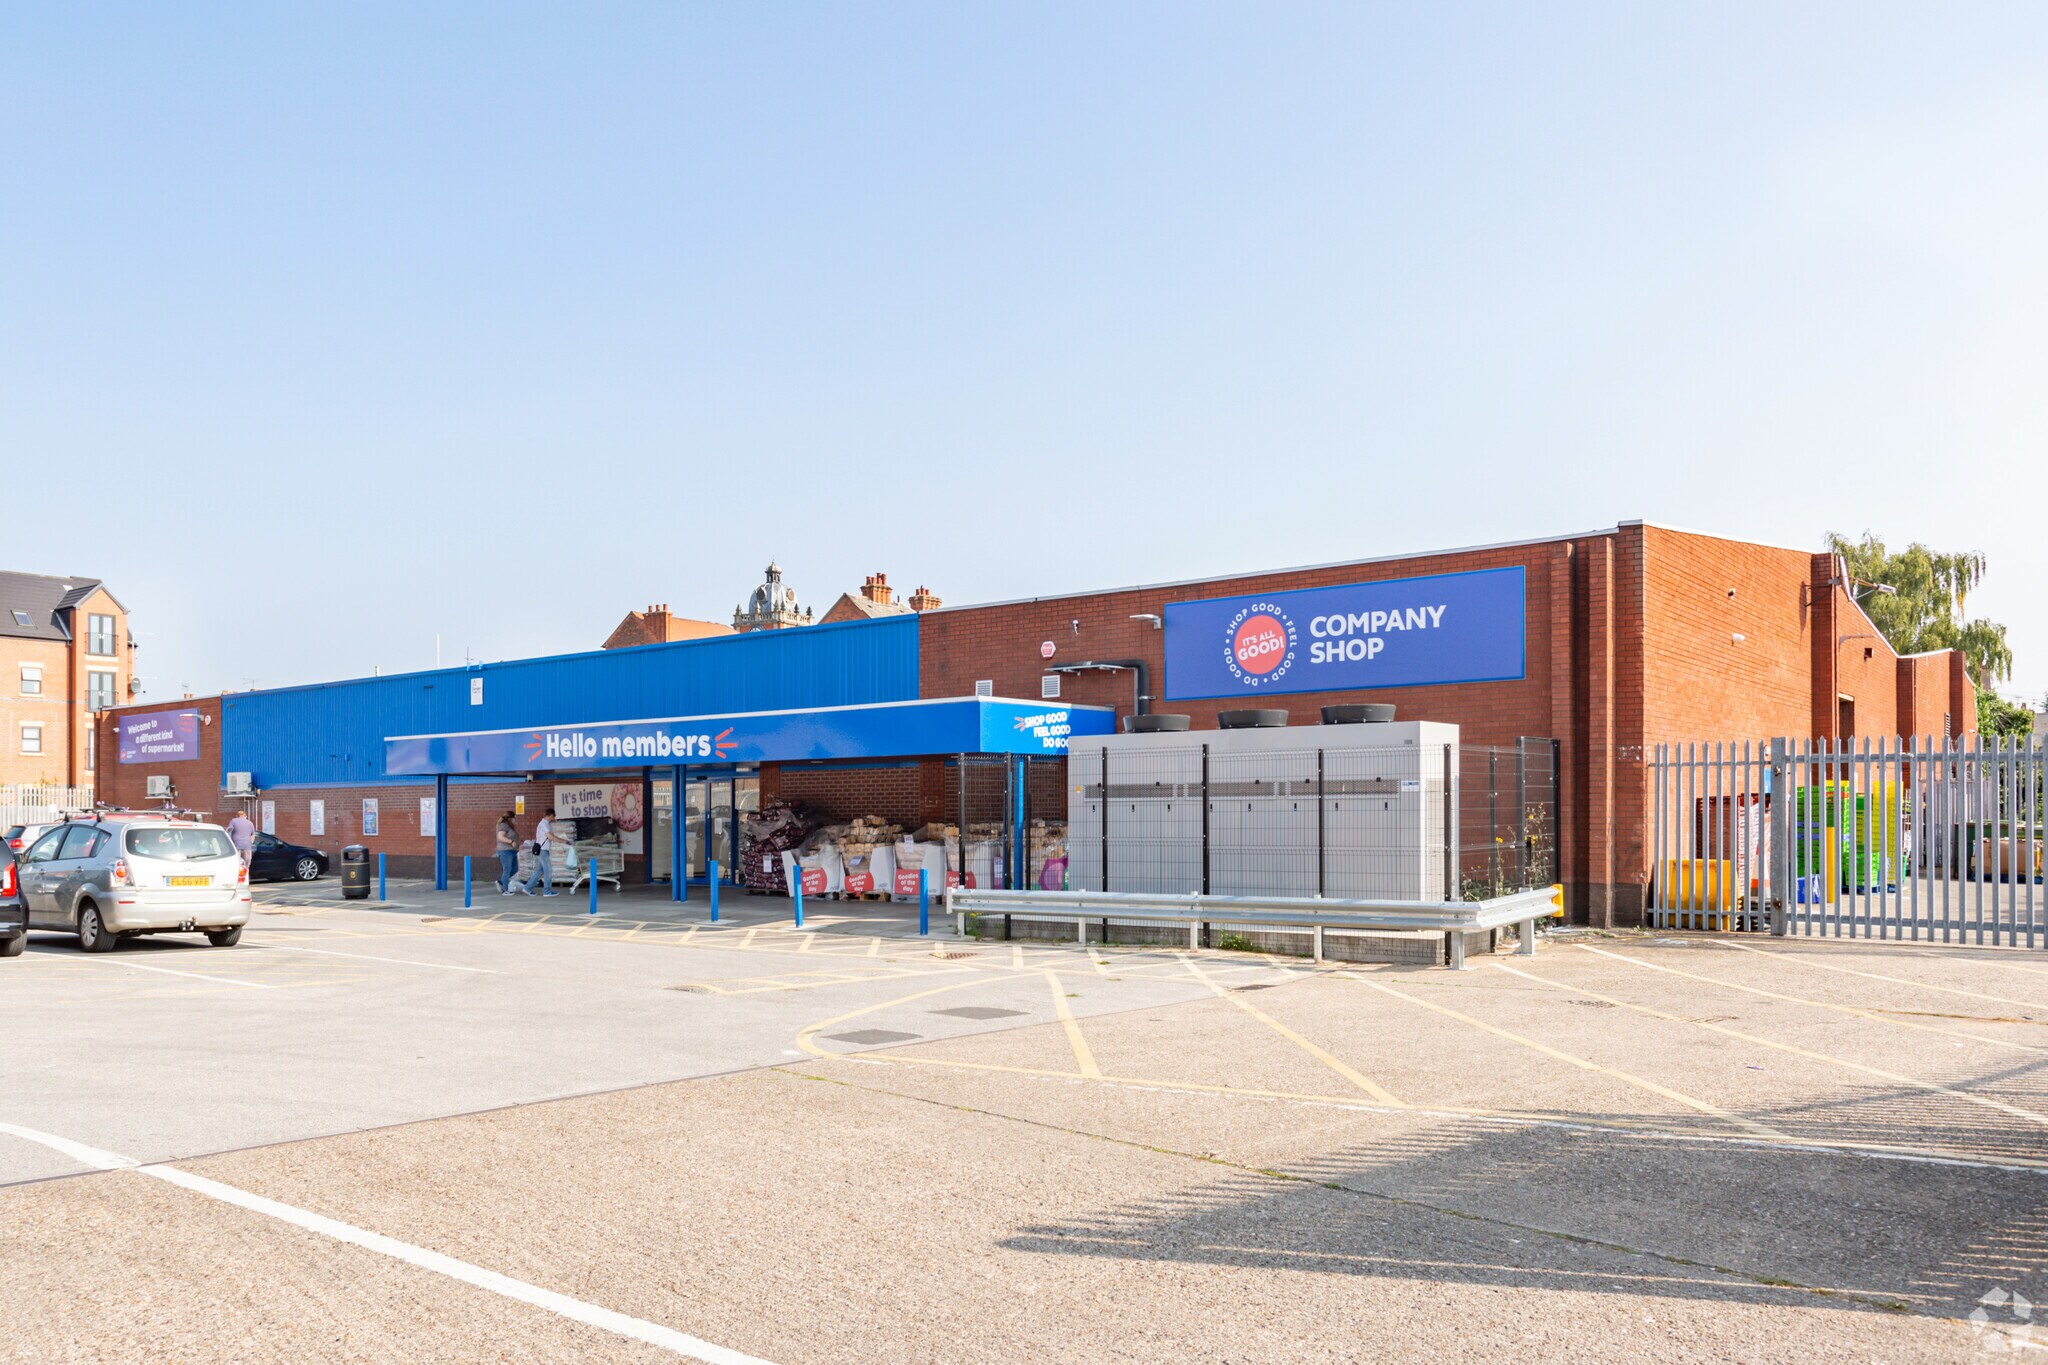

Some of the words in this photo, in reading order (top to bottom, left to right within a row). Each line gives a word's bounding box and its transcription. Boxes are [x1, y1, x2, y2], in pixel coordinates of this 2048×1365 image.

[1226, 608, 1248, 635] SHOP
[1251, 603, 1282, 616] GOOD
[1309, 604, 1447, 638] COMPANY
[1242, 635, 1258, 646] IT'S
[1259, 630, 1275, 641] ALL
[1285, 620, 1298, 648] FEEL
[1238, 636, 1284, 661] GOOD!
[1309, 638, 1385, 664] SHOP
[1224, 648, 1241, 678] GOOD
[1271, 652, 1295, 681] GOOD
[1243, 676, 1258, 686] DO
[128, 722, 151, 735] Welcome
[151, 720, 158, 728] to
[1024, 715, 1044, 728] SHOP
[1046, 712, 1068, 724] GOOD
[139, 733, 161, 743] different
[161, 729, 173, 740] kind
[1033, 726, 1050, 737] FEEL
[1050, 725, 1071, 736] GOOD
[142, 743, 148, 753] of
[546, 732, 597, 758] Hello
[602, 731, 711, 757] members
[1043, 737, 1055, 748] DO
[562, 792, 576, 805] It's
[579, 789, 602, 802] time
[571, 805, 581, 817] to
[583, 804, 608, 817] shop
[171, 877, 192, 886] FL56
[802, 873, 820, 882] Goodies
[849, 874, 866, 882] Goodies
